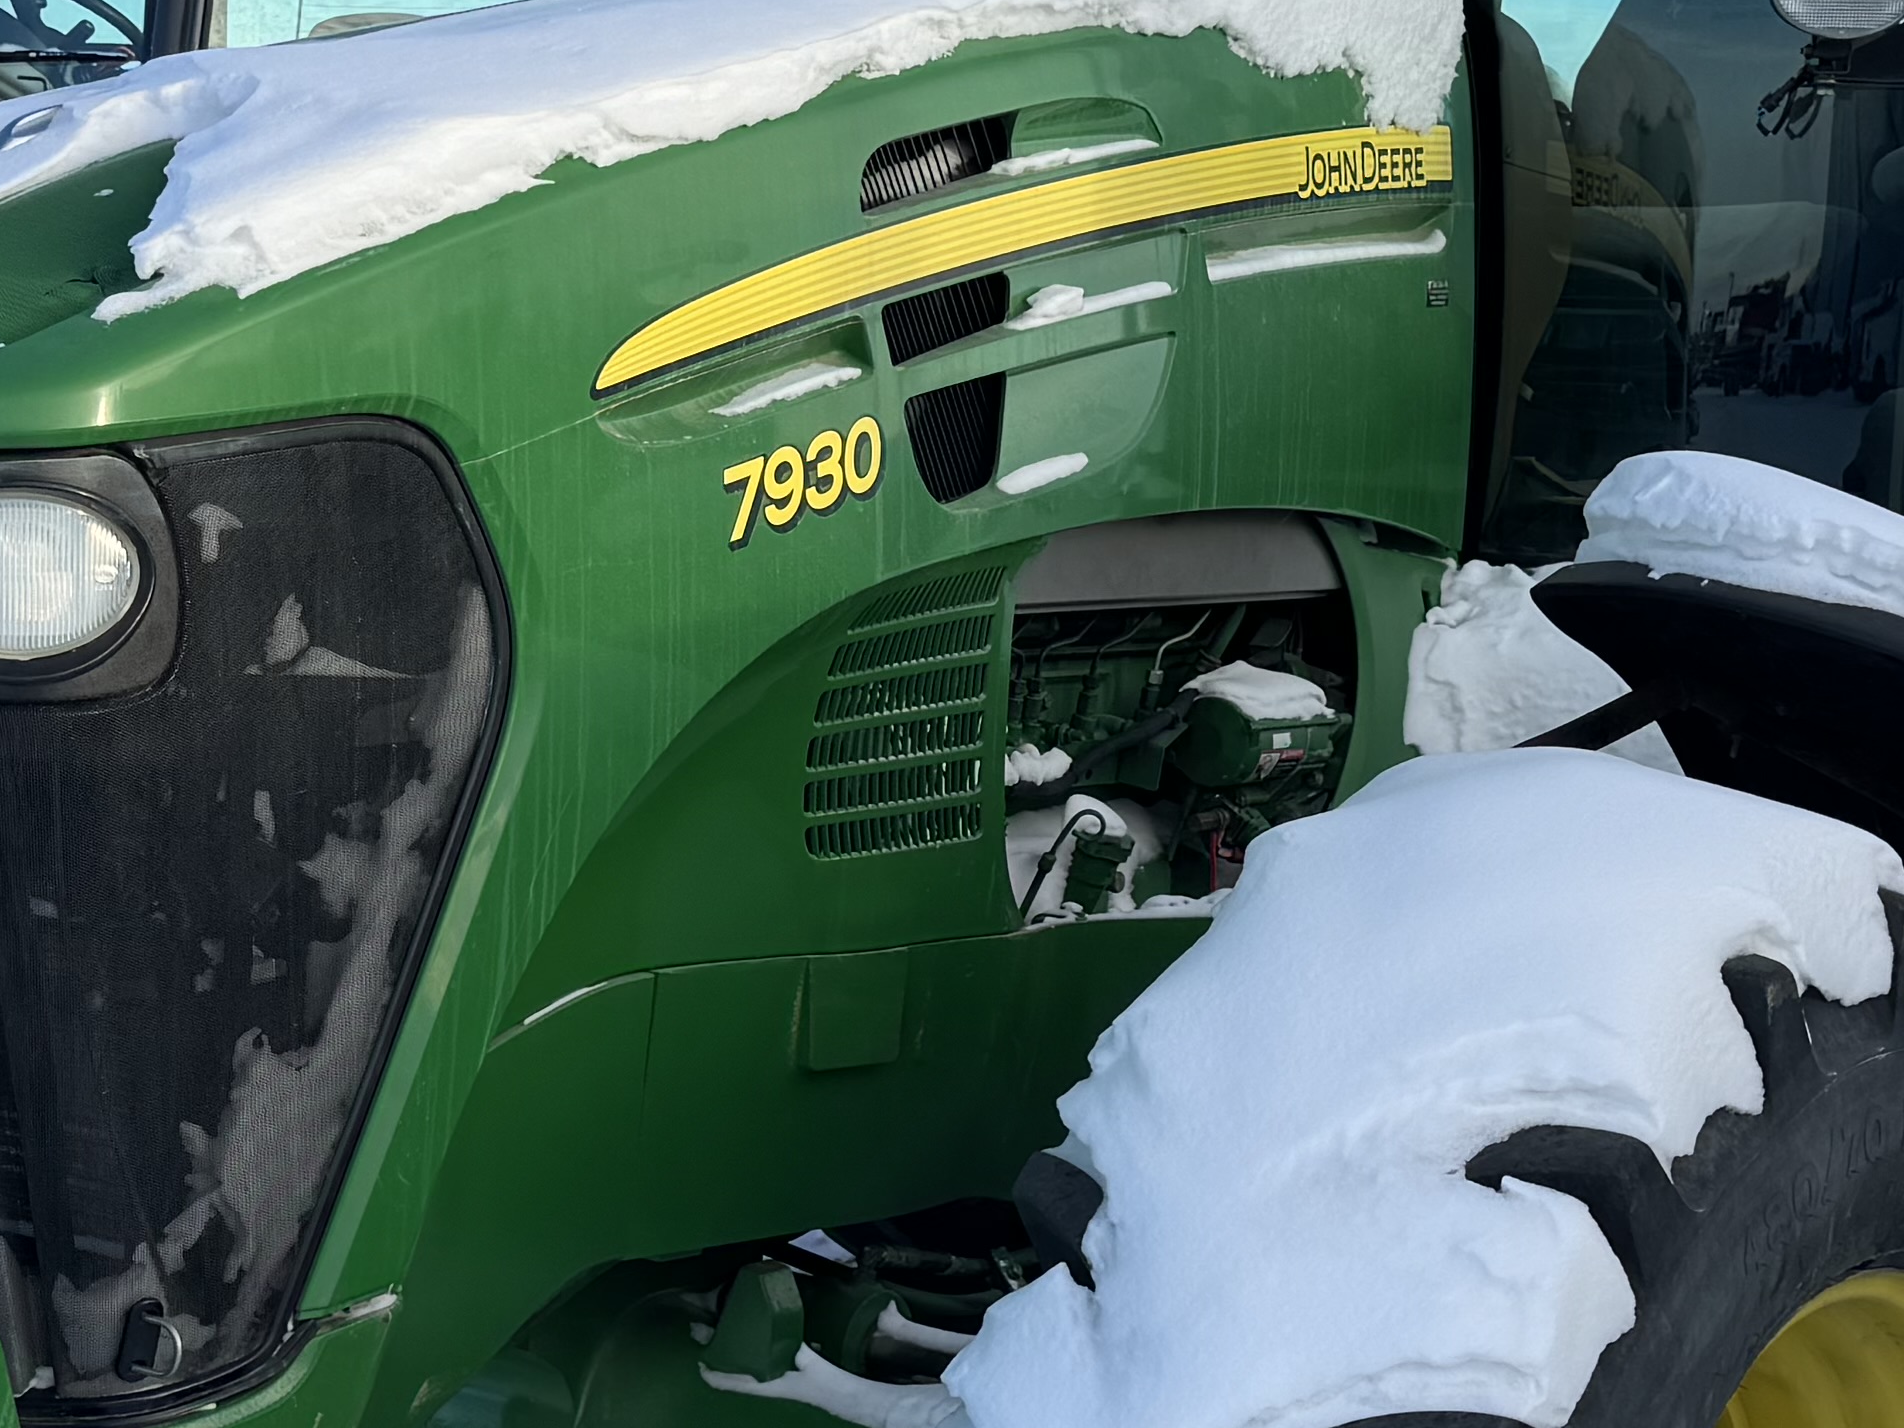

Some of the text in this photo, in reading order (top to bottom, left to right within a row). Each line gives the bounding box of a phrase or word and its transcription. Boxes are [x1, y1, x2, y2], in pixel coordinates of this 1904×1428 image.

[1298, 141, 1427, 198] JOHN DEERE
[723, 415, 884, 549] 7930
